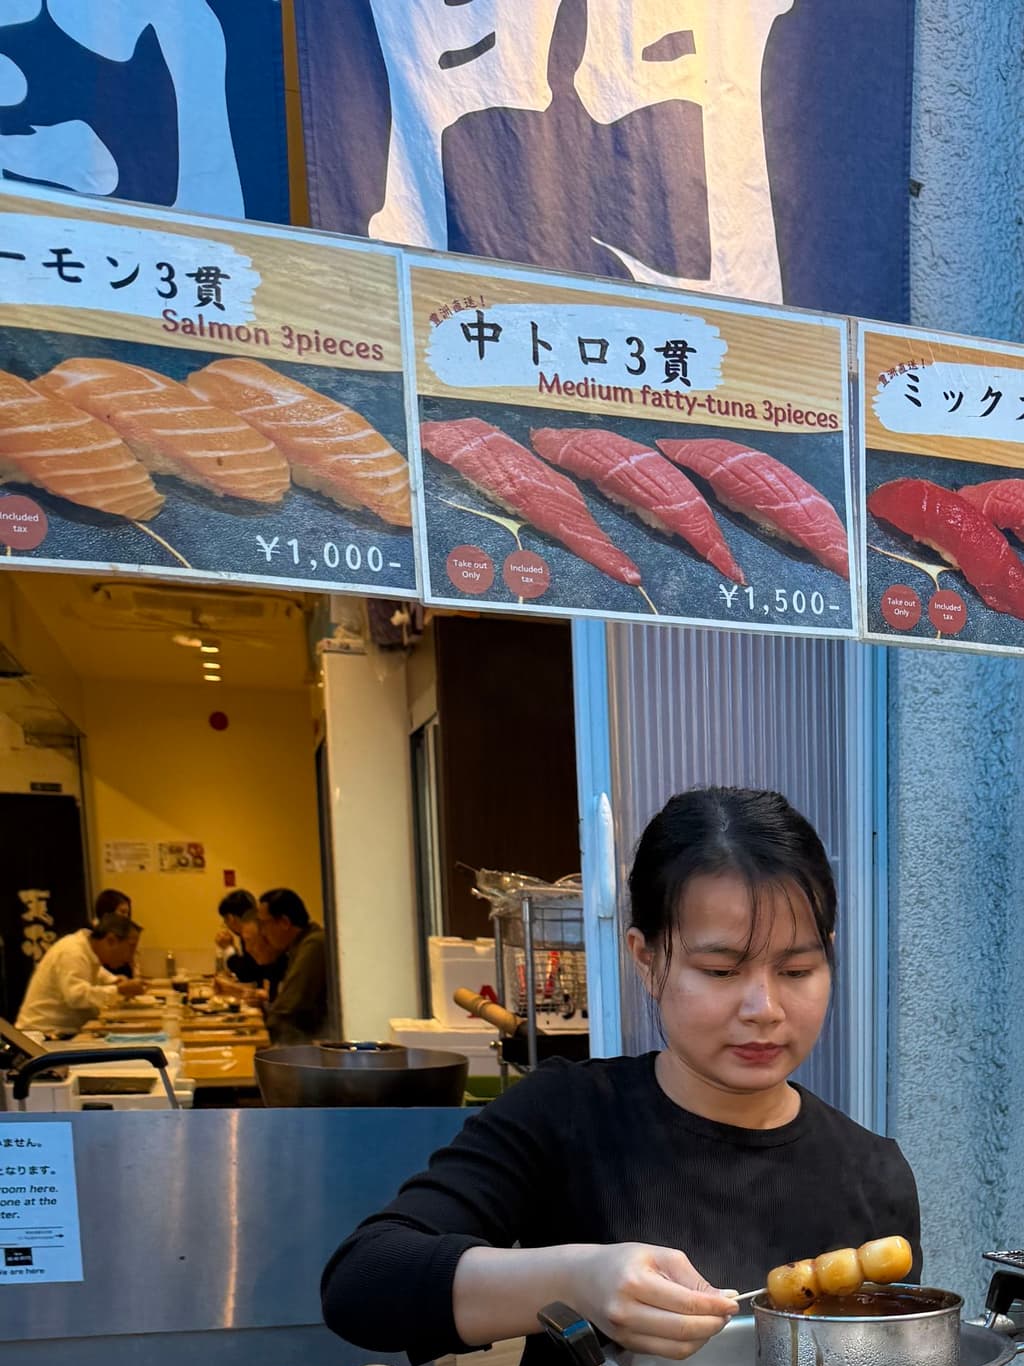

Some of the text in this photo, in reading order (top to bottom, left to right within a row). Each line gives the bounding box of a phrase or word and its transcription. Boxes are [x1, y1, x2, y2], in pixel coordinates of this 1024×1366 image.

[162, 308, 384, 361] Salmon 3pieces
[460, 311, 697, 387] 中トロ3貫
[538, 371, 839, 430] Medium fatty-tuna 3pieces
[256, 535, 400, 572] ¥1,000-
[453, 560, 472, 569] Take
[510, 564, 543, 574] Included
[461, 570, 480, 581] Only
[521, 575, 534, 583] tax
[719, 584, 840, 616] ¥1,500-
[887, 597, 916, 607] Take out
[894, 607, 909, 617] Only
[934, 602, 961, 612] Included
[943, 612, 953, 620] tax
[29, 1184, 58, 1193] here.
[24, 1198, 35, 1206] at
[39, 1196, 57, 1206] the
